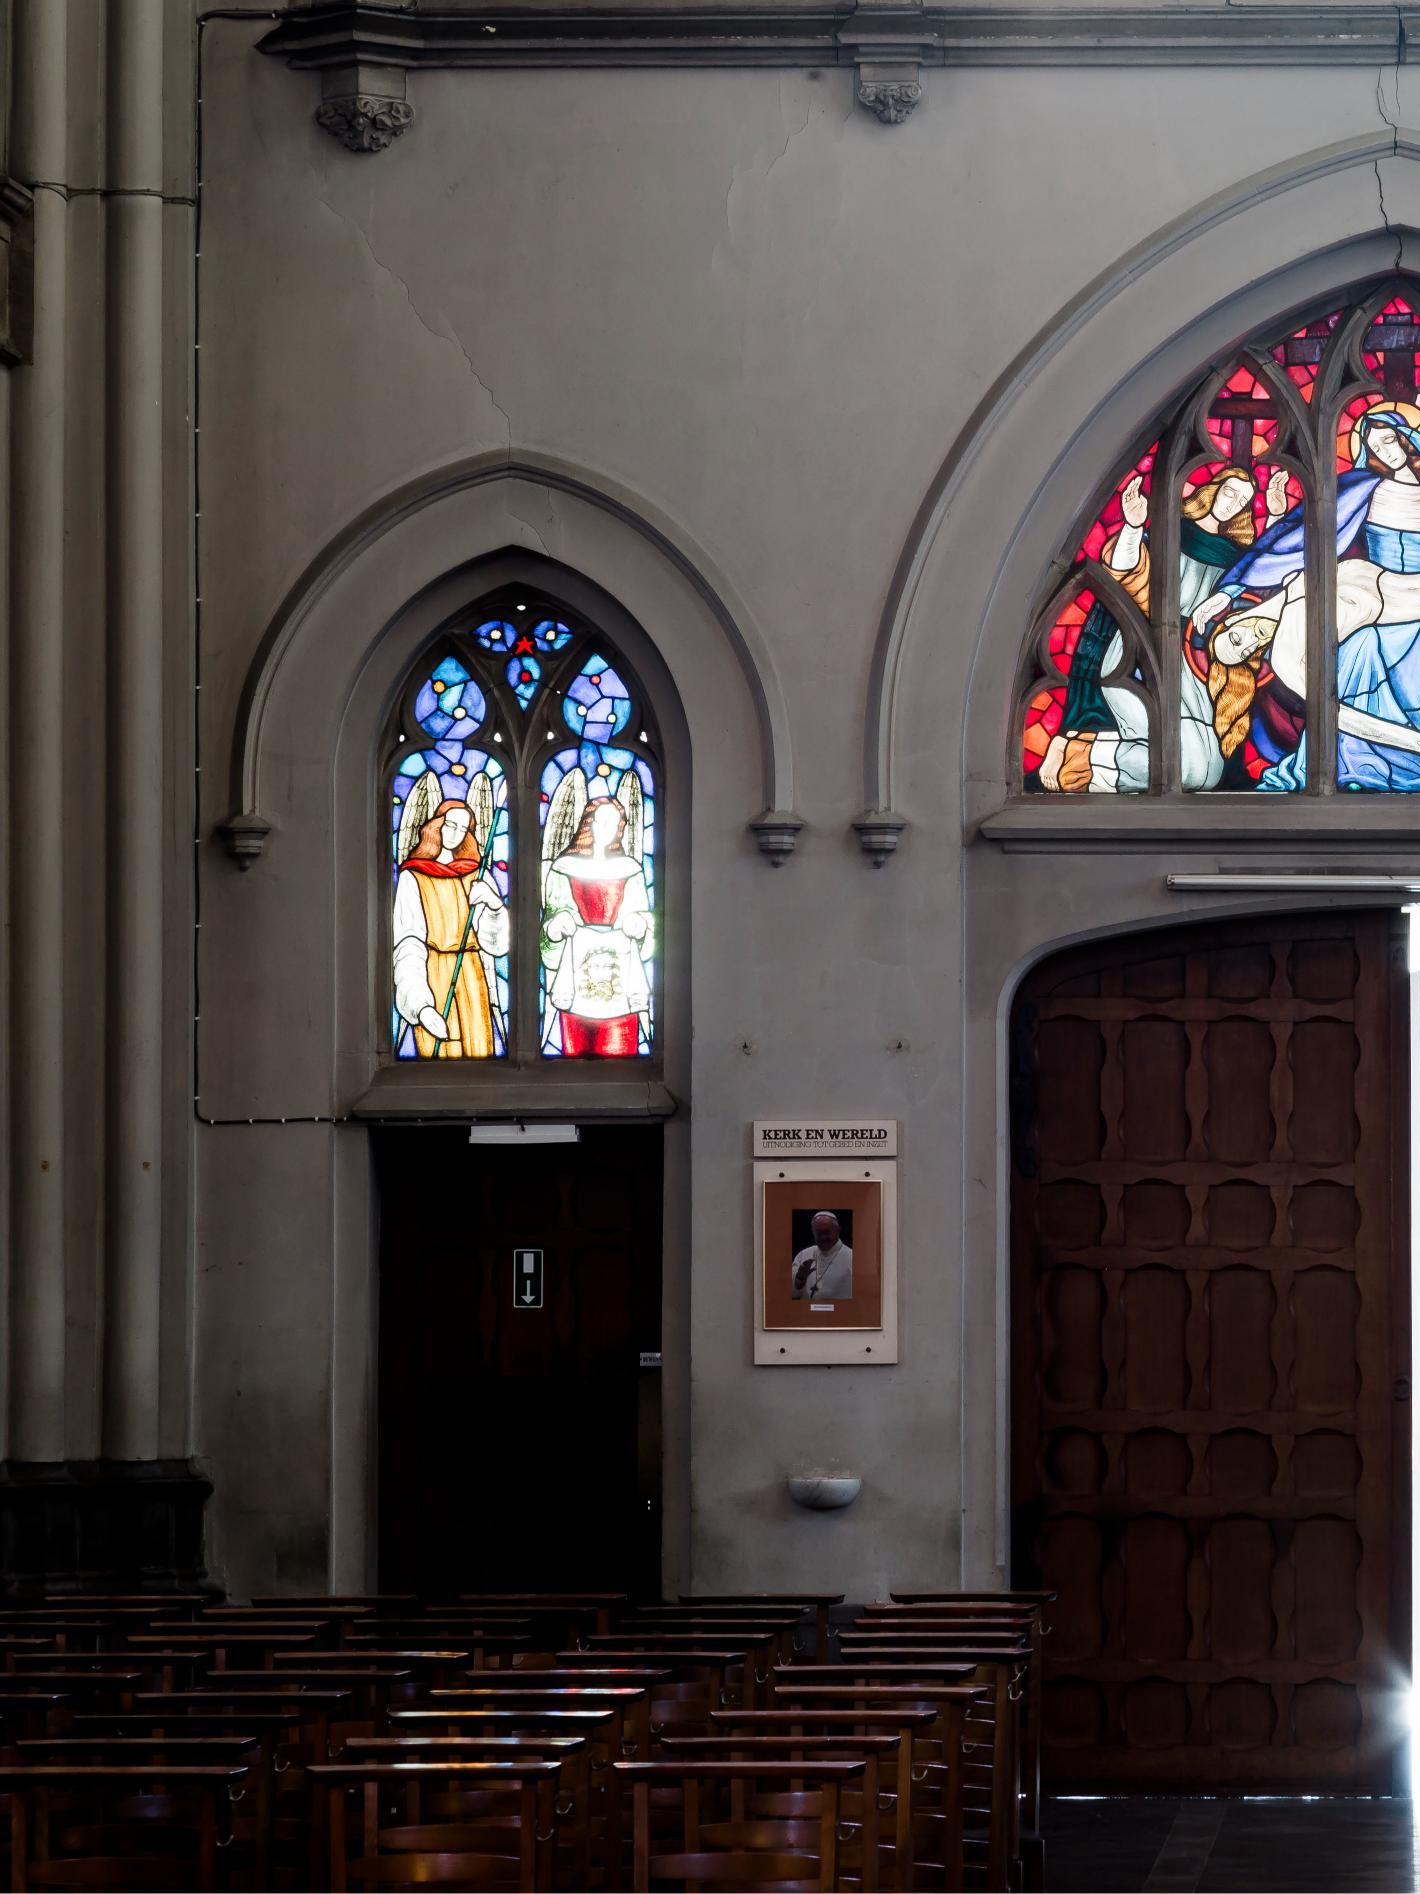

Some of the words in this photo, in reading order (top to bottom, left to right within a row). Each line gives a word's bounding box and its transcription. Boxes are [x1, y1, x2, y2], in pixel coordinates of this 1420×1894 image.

[762, 1129, 803, 1140] KERK
[805, 1129, 825, 1140] EN
[827, 1129, 888, 1140] WERELD
